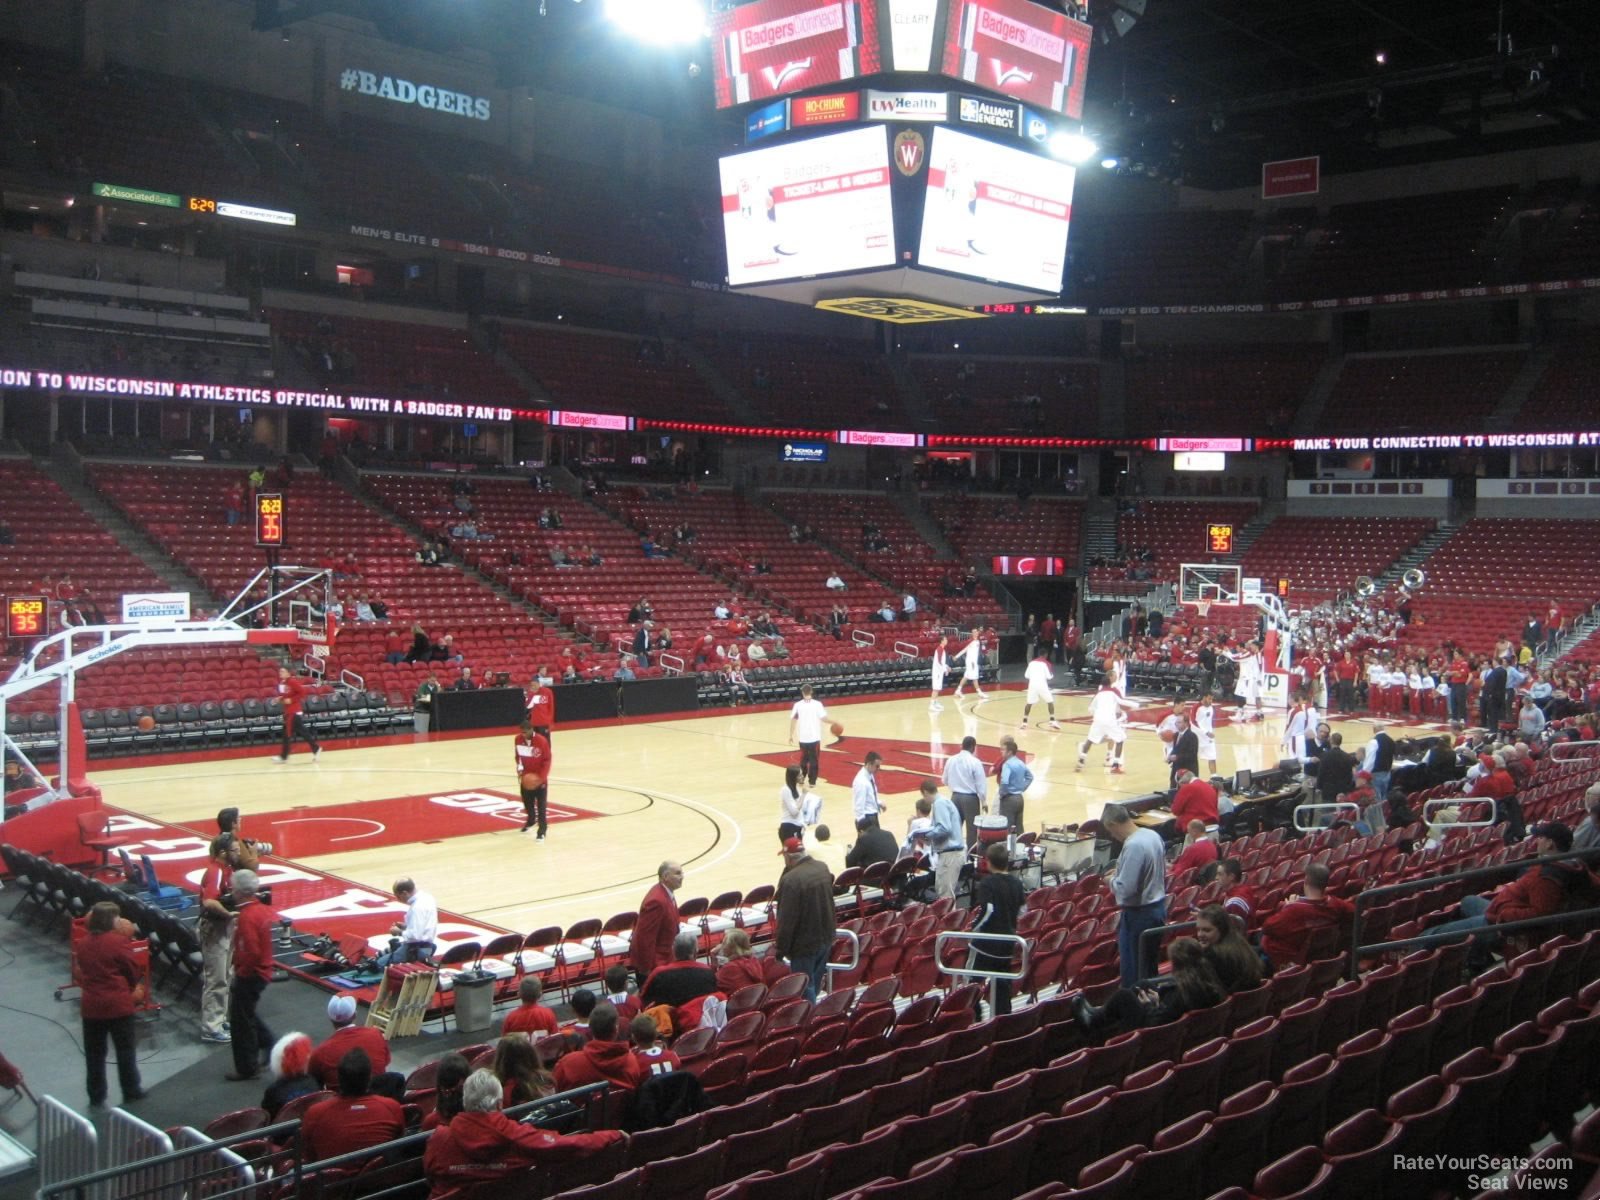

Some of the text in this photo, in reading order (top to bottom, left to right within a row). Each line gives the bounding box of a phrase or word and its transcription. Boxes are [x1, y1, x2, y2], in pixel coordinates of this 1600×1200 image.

[340, 68, 491, 121] #BADGERS
[805, 97, 846, 114] HO-CHUNK
[979, 102, 1015, 119] ALLIANT
[189, 197, 215, 212] 6:29
[351, 225, 392, 240] MEN'S
[394, 231, 427, 245] ELITE
[1099, 306, 1137, 316] MEN'S
[1164, 305, 1188, 315] TEN
[1190, 304, 1265, 314] CHAMPIONS
[38, 373, 62, 388] TO
[69, 375, 175, 397] WISCONSIN
[179, 383, 272, 403] ATHLETICS
[276, 391, 345, 409] OFFICIAL
[349, 397, 390, 412] WITH
[392, 399, 404, 413] A
[406, 401, 463, 418] BADGER
[466, 406, 494, 420] FAN
[497, 408, 512, 421] ID
[1293, 439, 1331, 451] MAKE
[1334, 438, 1369, 450] YOUR
[1372, 436, 1461, 449] CONNECTION
[1464, 436, 1485, 448] TO
[1488, 433, 1574, 448] WISCONSIN
[263, 514, 280, 539] 35
[1212, 535, 1229, 551] 35
[11, 601, 43, 615] 26:23
[17, 615, 38, 631] 35
